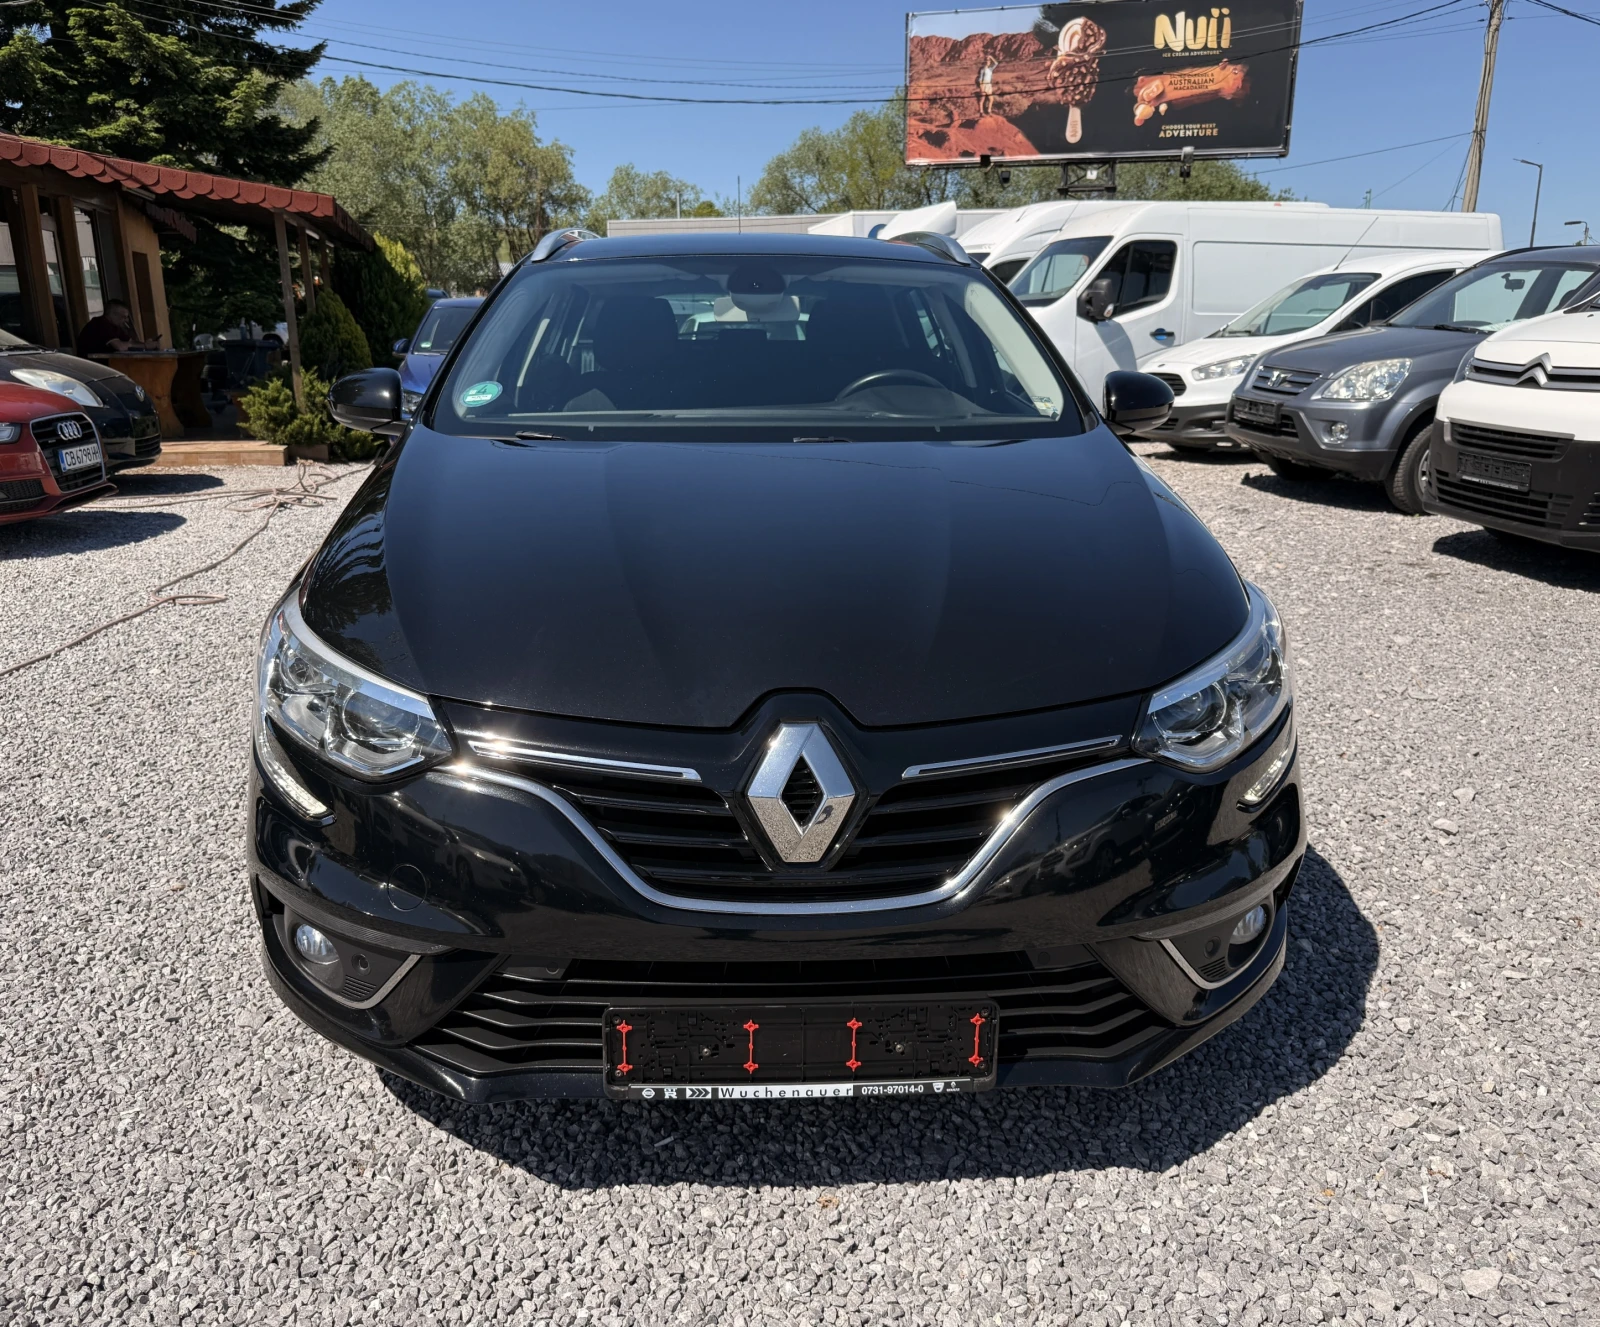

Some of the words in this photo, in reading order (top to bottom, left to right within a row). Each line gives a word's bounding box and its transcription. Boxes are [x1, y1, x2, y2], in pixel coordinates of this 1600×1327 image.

[1154, 7, 1232, 51] Nuii
[1168, 78, 1215, 86] AUSTRALIAN
[1158, 128, 1219, 138] ADVENTURE
[721, 1087, 852, 1098] Wuchenauer
[861, 1084, 924, 1095] 0731-97014-0
